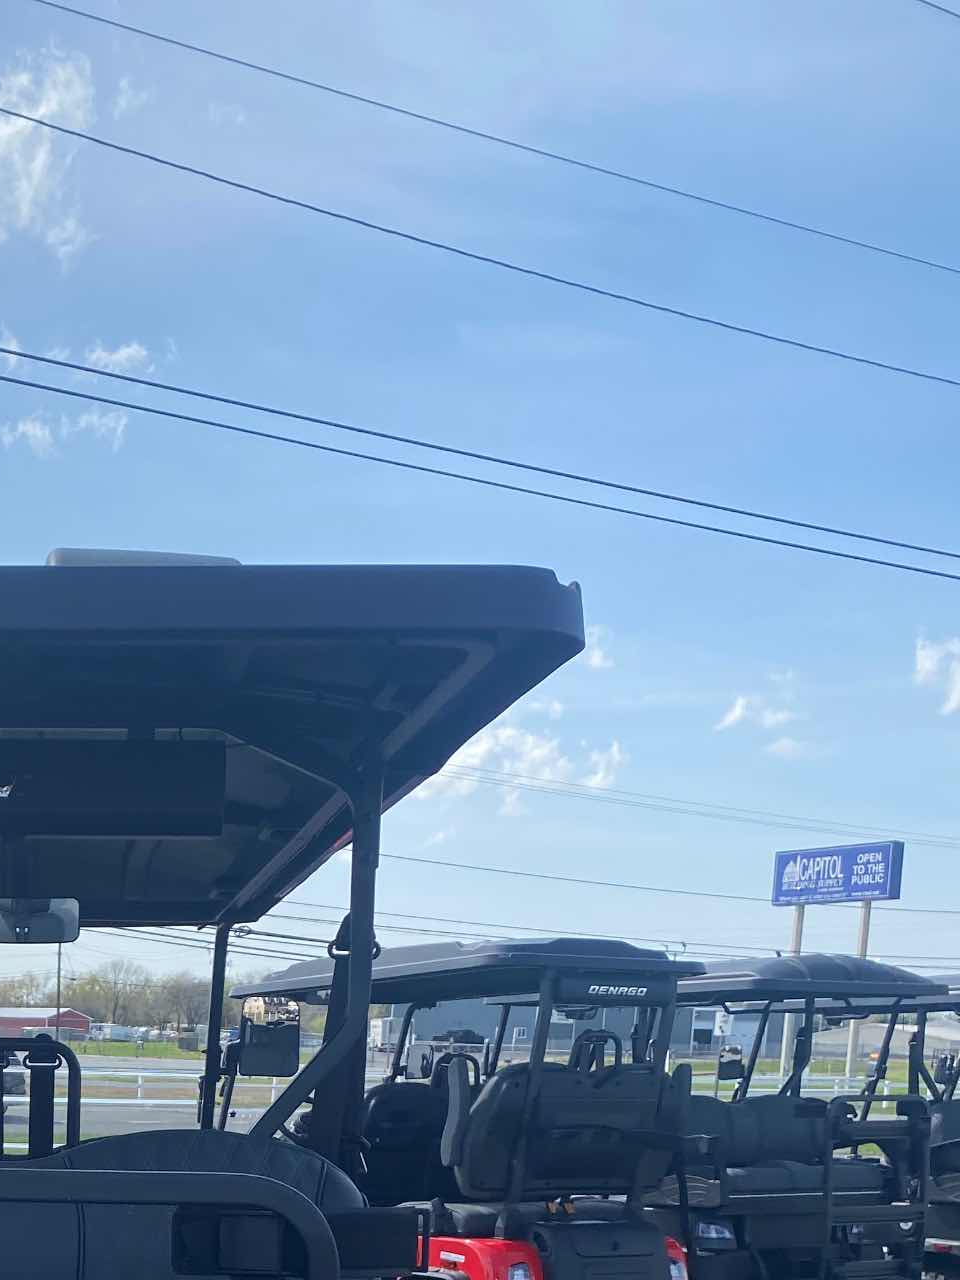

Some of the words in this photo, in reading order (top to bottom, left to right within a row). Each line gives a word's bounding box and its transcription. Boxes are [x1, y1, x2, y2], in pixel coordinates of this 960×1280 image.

[857, 852, 882, 863] OPEN
[800, 855, 843, 880] CAPITOL
[853, 865, 865, 874] TO
[867, 863, 885, 873] THE
[851, 873, 884, 885] PUBLIC
[588, 985, 647, 996] DENAGO
